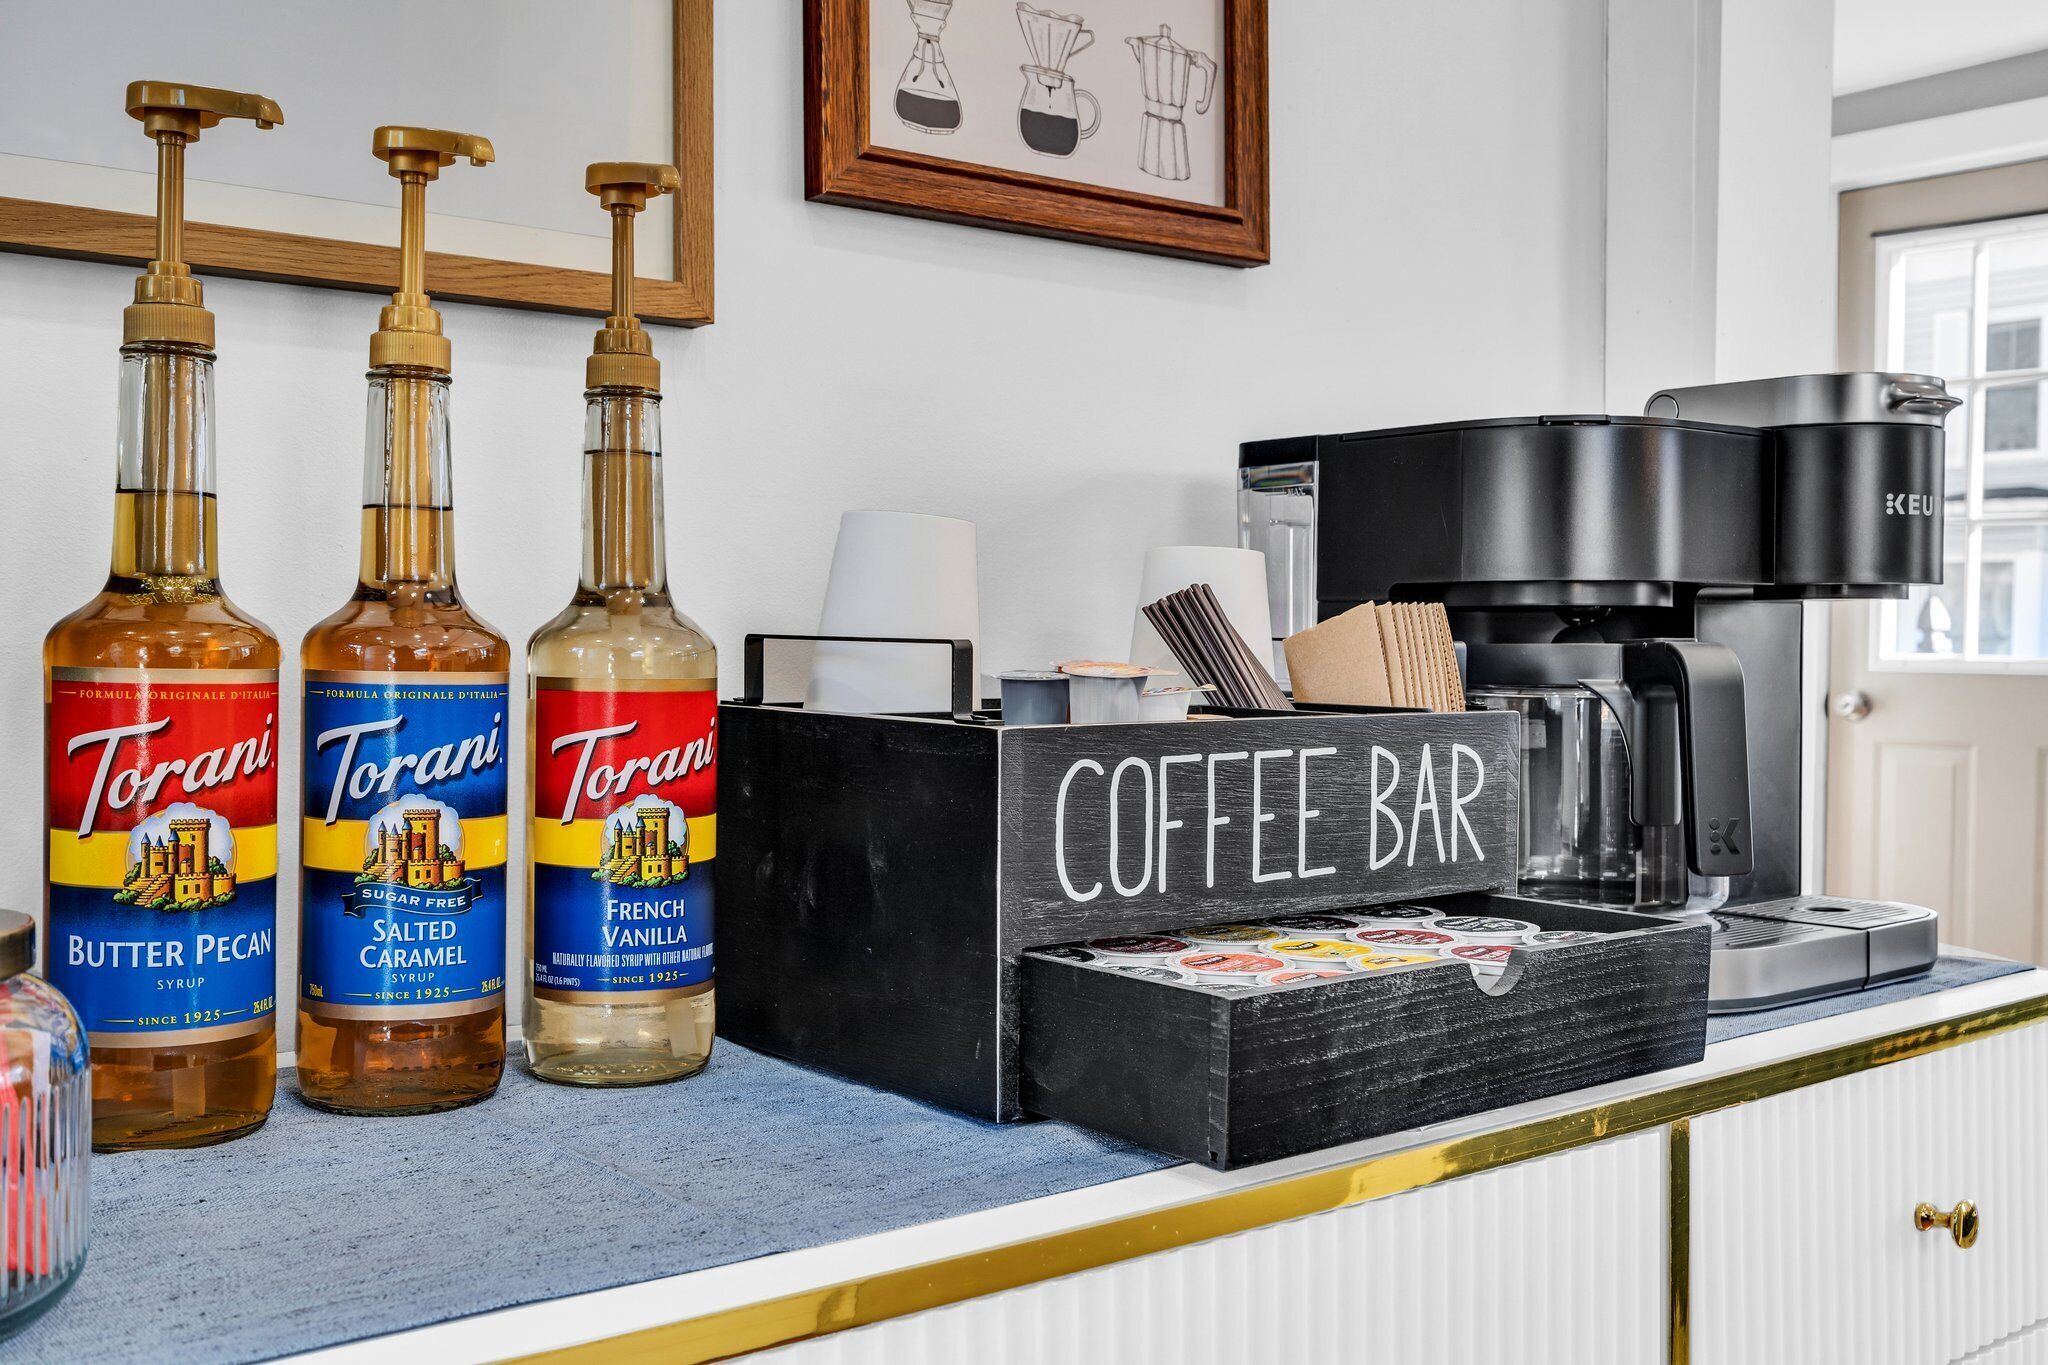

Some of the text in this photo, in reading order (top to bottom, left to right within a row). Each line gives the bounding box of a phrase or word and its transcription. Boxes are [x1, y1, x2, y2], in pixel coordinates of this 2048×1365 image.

[80, 689, 271, 701] FORMULA ORIGINALE D'ITALIA
[326, 689, 499, 700] FORMULA ORIGINALE D'ITALIA
[67, 712, 273, 840] Torani
[317, 711, 501, 826] Torani
[551, 716, 715, 825] Torani
[1055, 743, 1485, 903] COFFEE BAR
[362, 888, 466, 909] SUGAR FREE
[606, 899, 686, 921] FRENCH
[372, 919, 457, 943] SALTED
[602, 924, 688, 948] VANILLA
[68, 928, 272, 968] BUTTER PECAN
[359, 945, 468, 970] CARAMEL
[552, 952, 585, 967] NATURALLY
[586, 954, 620, 967] FLAVORED
[621, 953, 643, 967] SYRUP
[644, 953, 660, 966] WITH
[662, 951, 680, 965] OTHER
[157, 977, 205, 991] SYRUP
[391, 972, 435, 983] SYRUP
[612, 971, 678, 984] SINCE 1925
[375, 987, 450, 1000] SINCE 1925
[138, 1010, 221, 1026] SINCE 1925
